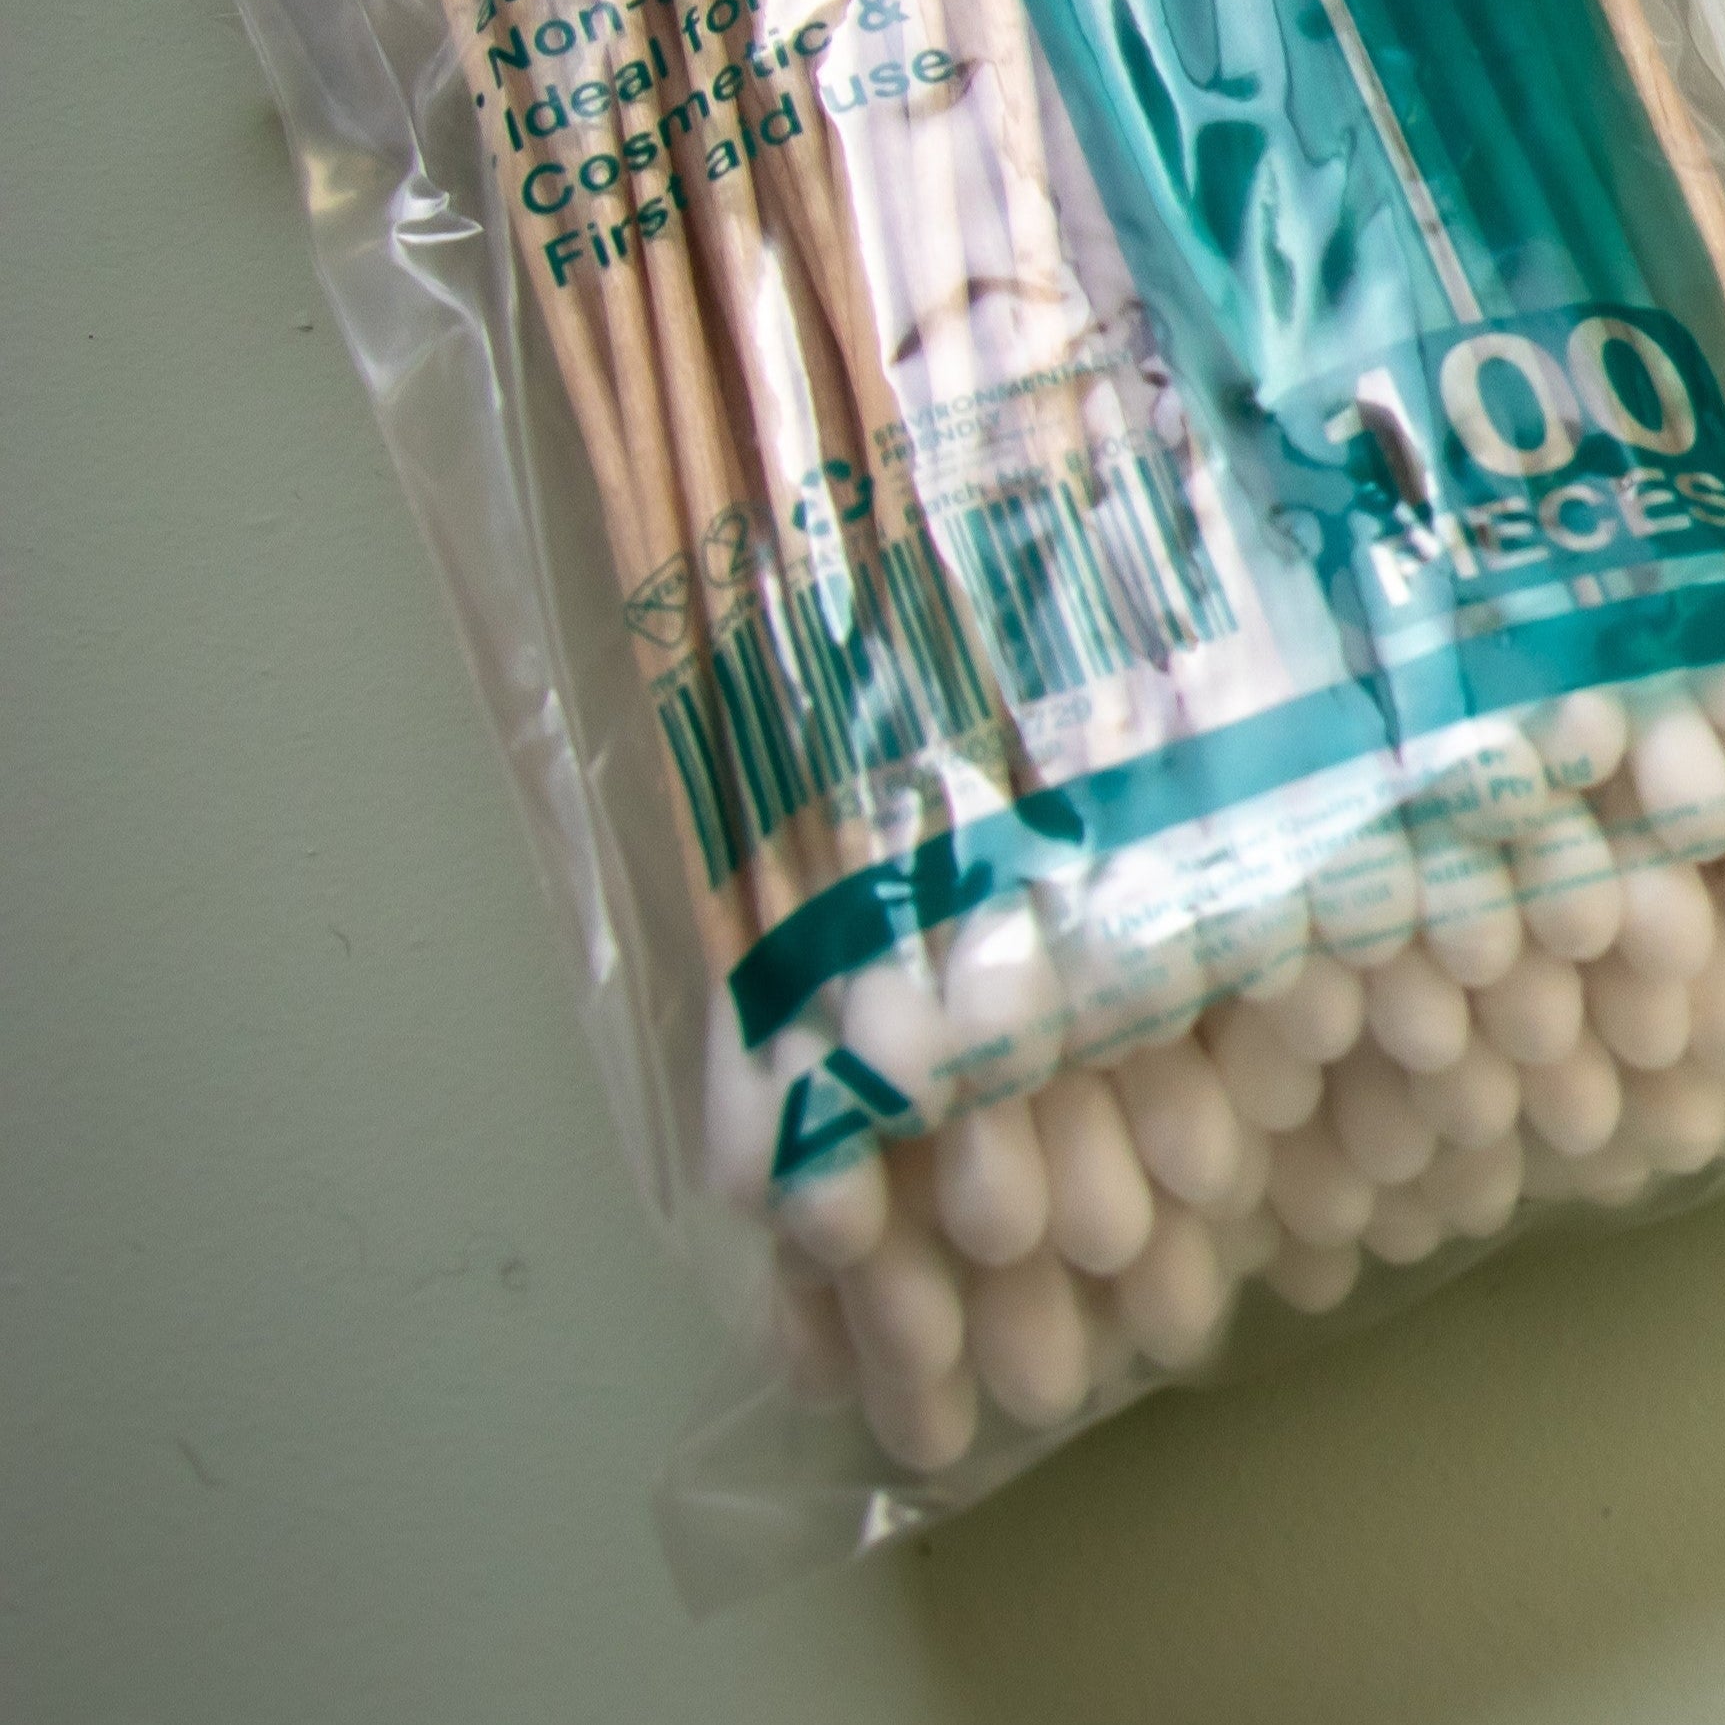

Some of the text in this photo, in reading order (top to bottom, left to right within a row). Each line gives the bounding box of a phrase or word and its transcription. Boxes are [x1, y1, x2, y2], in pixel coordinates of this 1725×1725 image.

[503, 36, 669, 152] Ideal
[520, 21, 832, 215] Cosmetic
[542, 47, 956, 289] First aid use
[1325, 316, 1698, 516] 100
